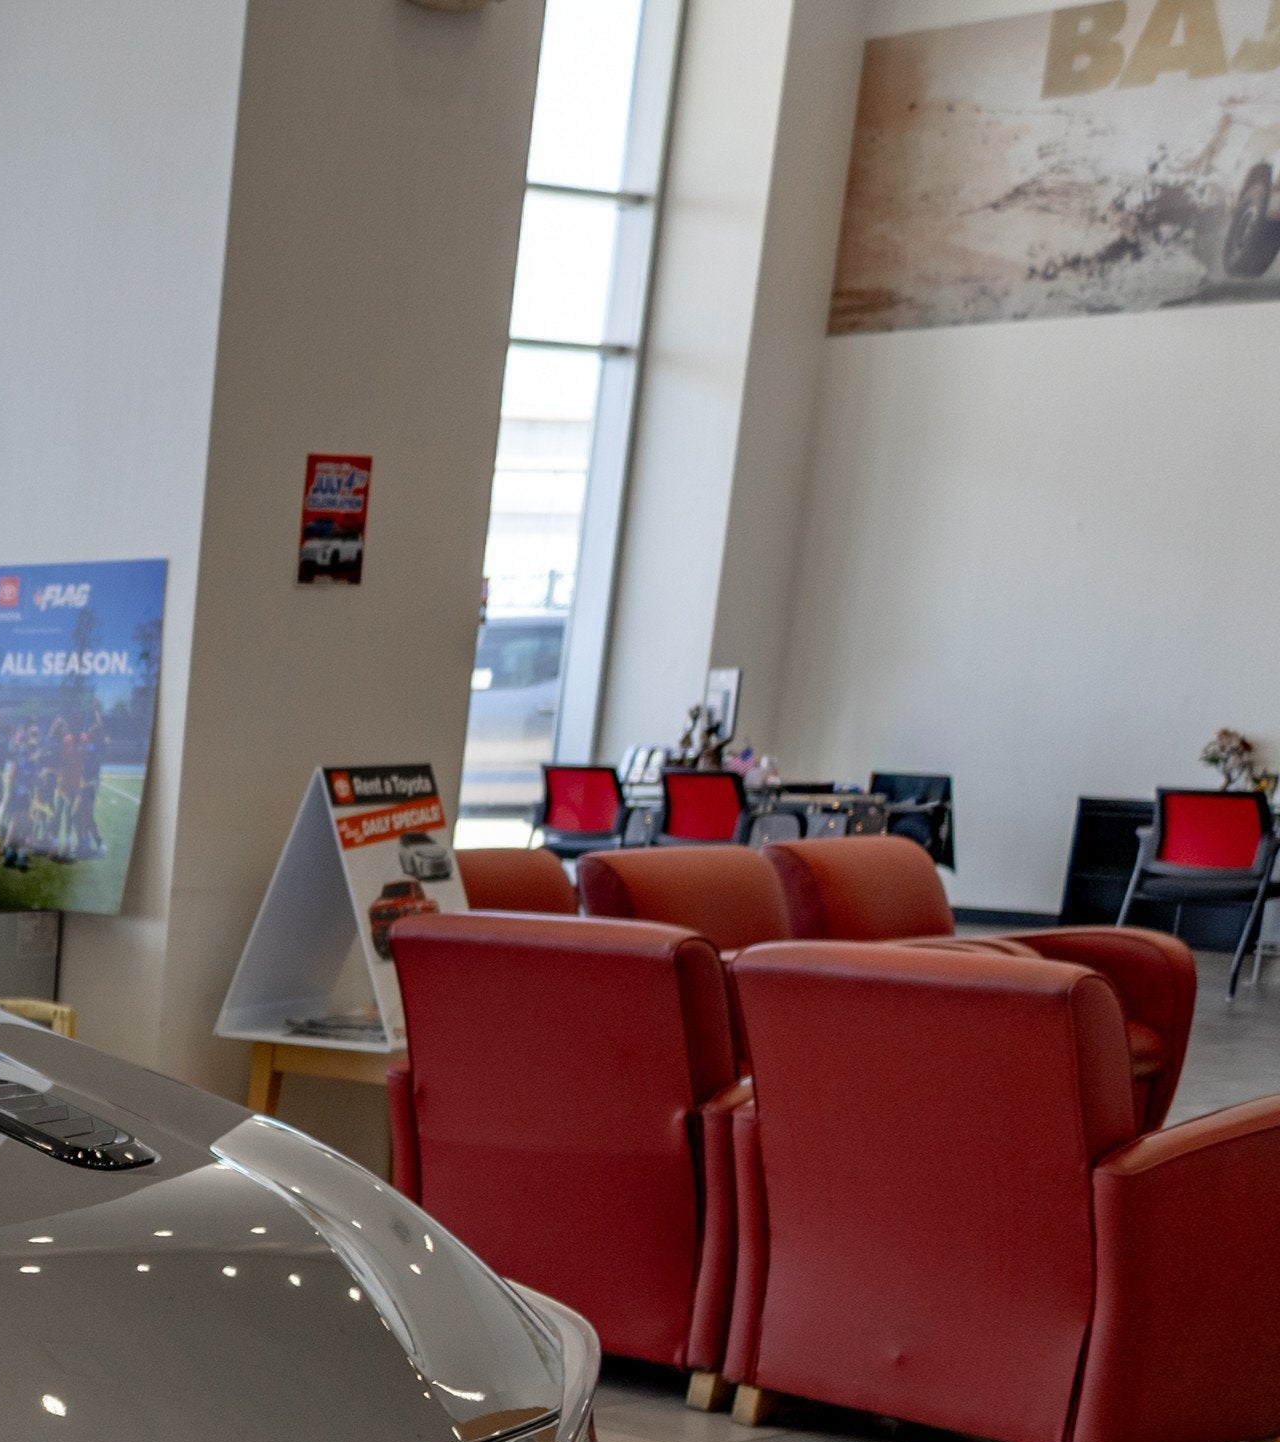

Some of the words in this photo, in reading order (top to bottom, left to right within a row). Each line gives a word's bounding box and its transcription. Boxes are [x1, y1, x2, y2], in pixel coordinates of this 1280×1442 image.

[0, 652, 37, 676] ALL
[42, 651, 133, 675] SEASON.
[391, 773, 433, 798] Toyota
